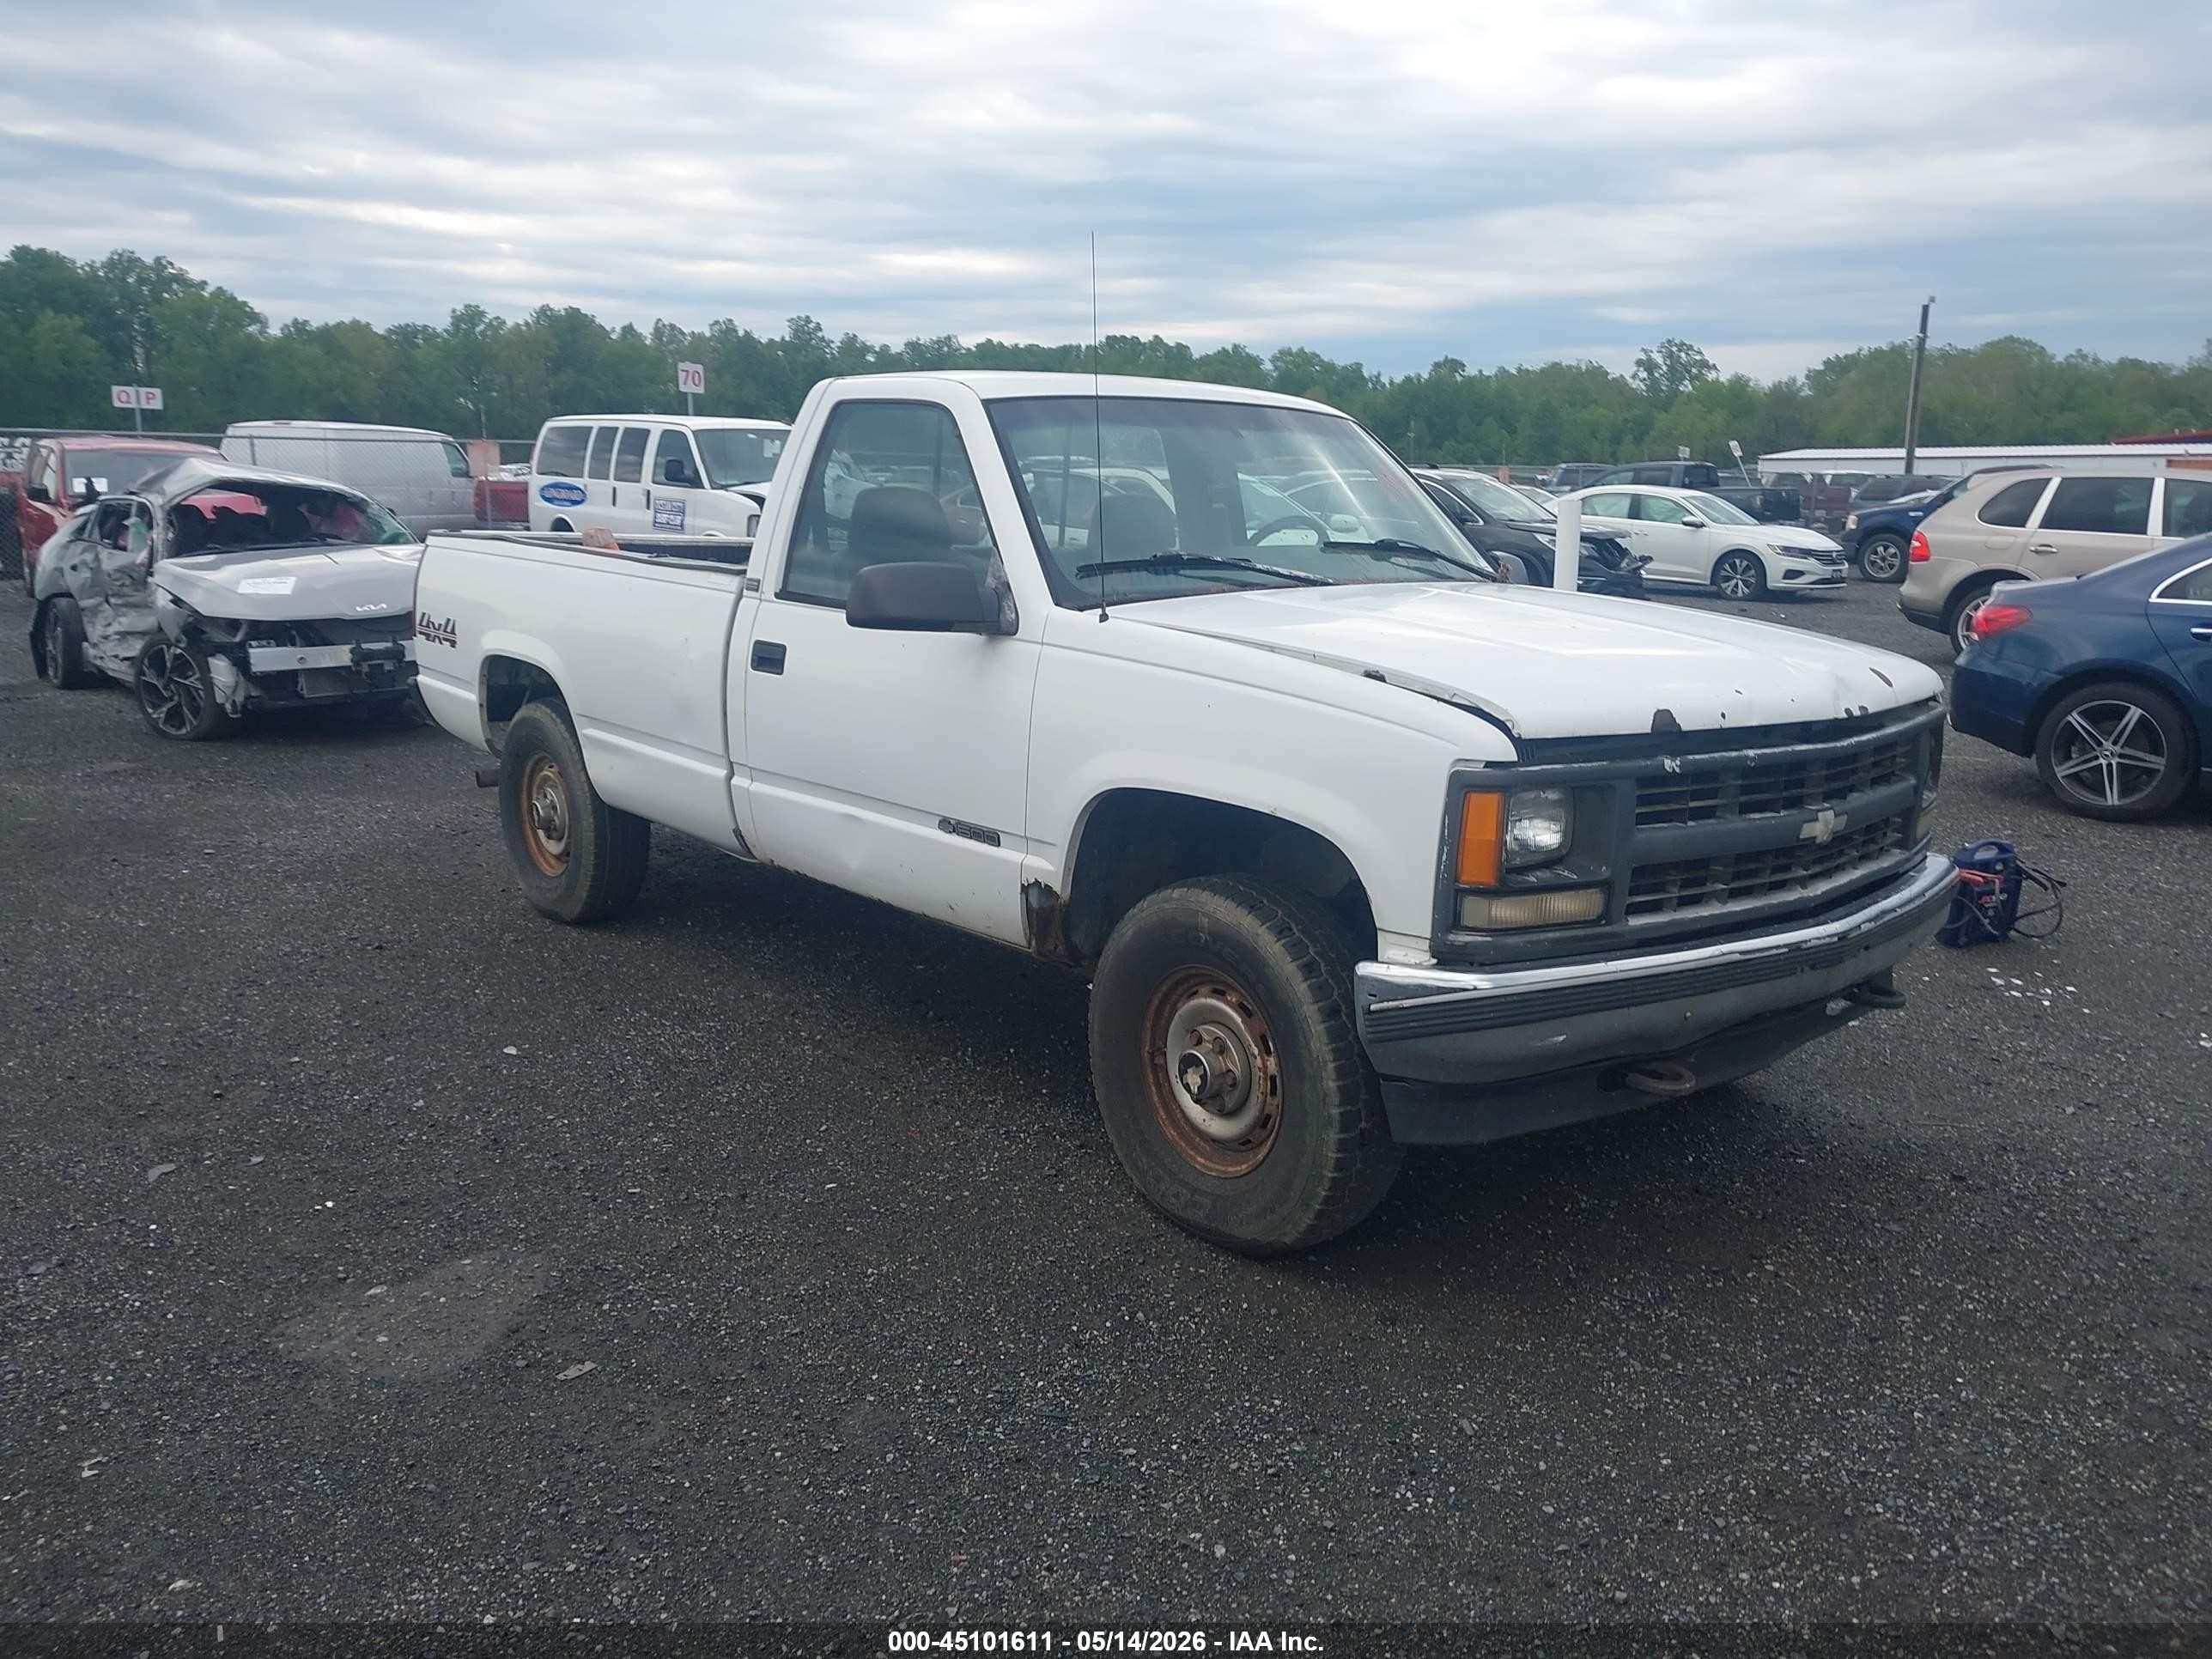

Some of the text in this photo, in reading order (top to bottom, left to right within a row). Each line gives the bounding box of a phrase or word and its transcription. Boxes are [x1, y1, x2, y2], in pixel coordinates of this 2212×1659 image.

[679, 369, 702, 386] 70
[117, 390, 156, 404] Q P
